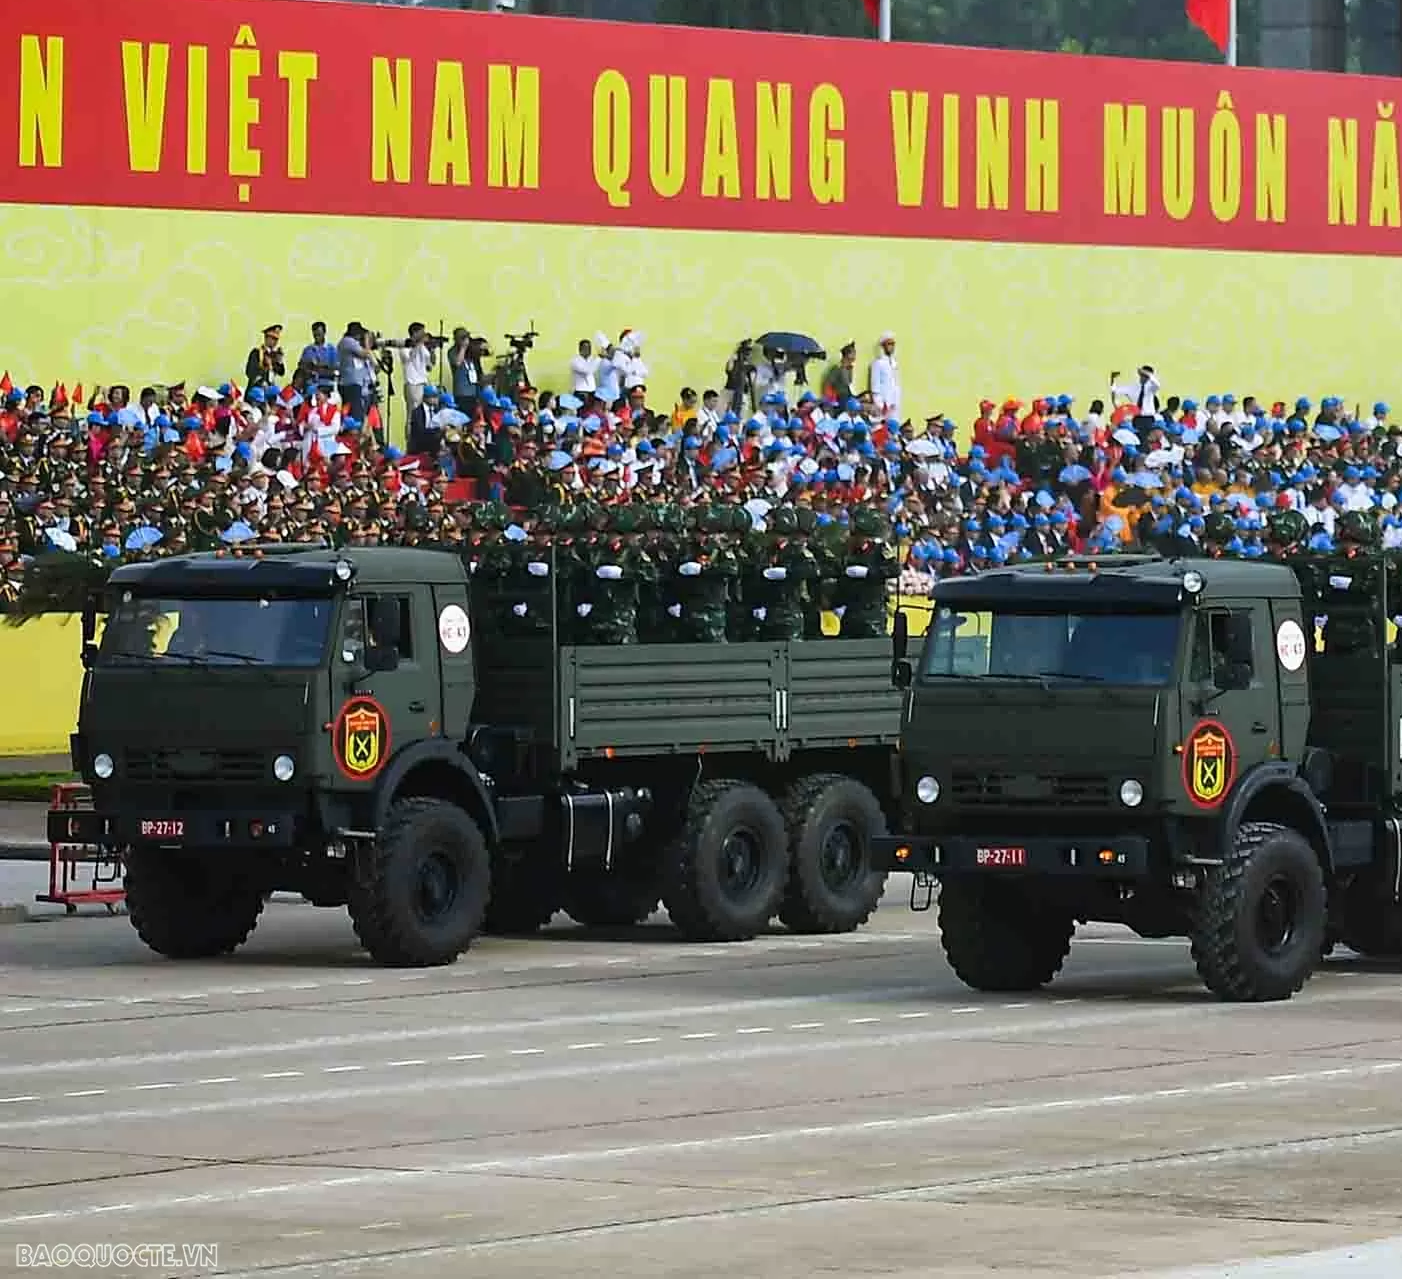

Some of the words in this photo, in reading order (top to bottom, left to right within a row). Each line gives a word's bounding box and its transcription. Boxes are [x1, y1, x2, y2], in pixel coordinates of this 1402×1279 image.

[121, 25, 319, 203] VIỆT
[371, 56, 540, 189] NAM
[592, 68, 845, 208] QUANG
[890, 89, 1060, 213] VINH
[1103, 90, 1287, 224] MUÔN
[142, 821, 184, 835] BP-27-12
[977, 849, 1022, 864] BP-27-11
